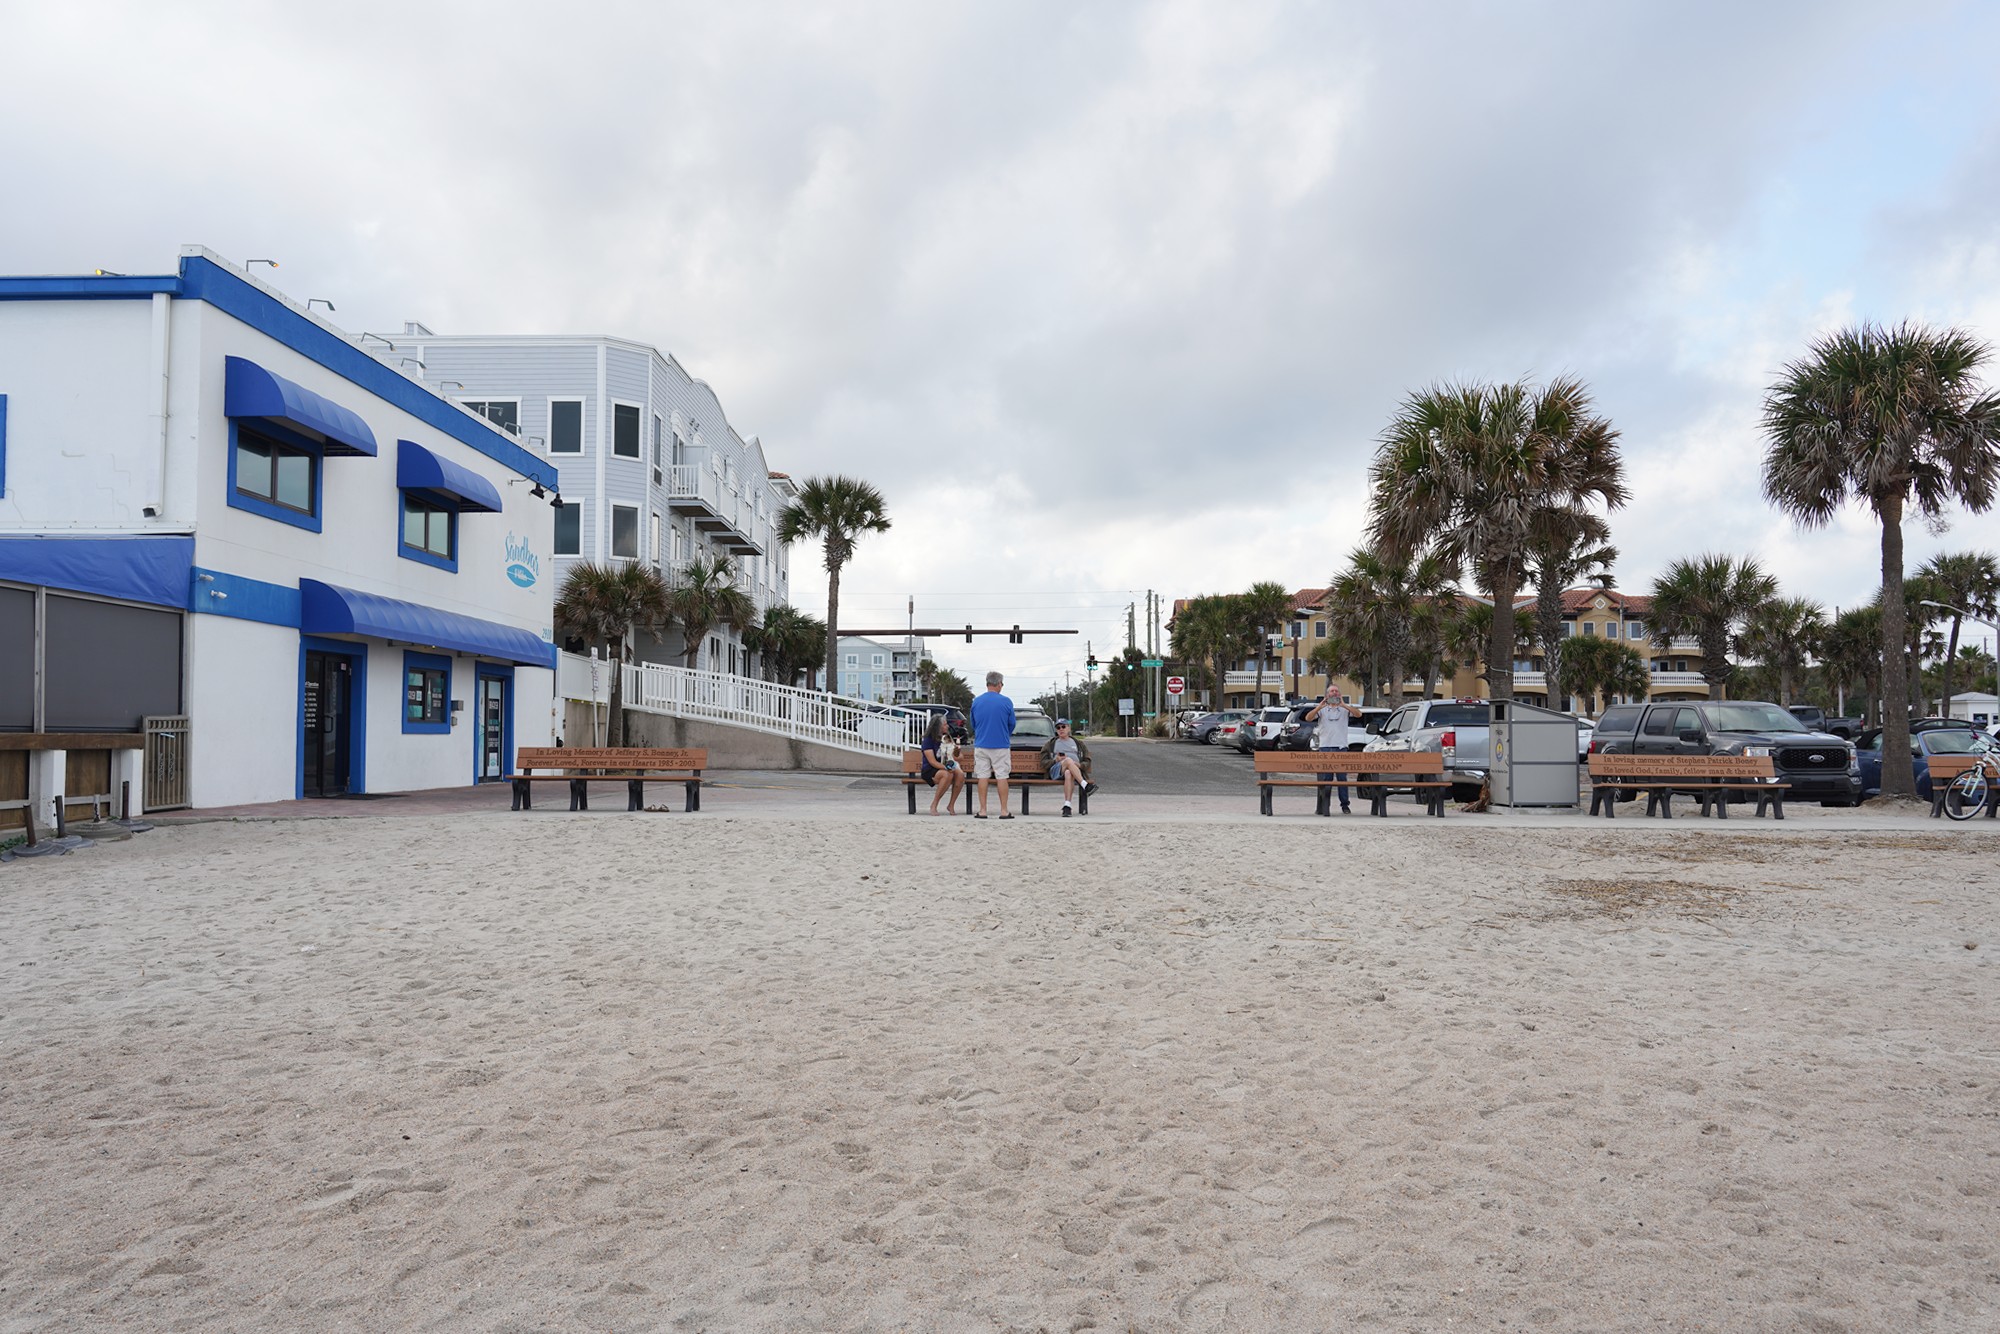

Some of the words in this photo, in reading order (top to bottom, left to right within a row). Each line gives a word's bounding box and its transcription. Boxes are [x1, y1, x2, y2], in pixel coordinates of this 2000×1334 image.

[536, 748, 545, 756] In
[546, 748, 572, 757] Loving
[574, 748, 604, 758] Memory
[605, 748, 613, 756] of
[615, 748, 641, 758] Jeffery
[642, 749, 650, 757] S.
[680, 750, 689, 758] Jr.
[1290, 752, 1328, 760] Dominick
[526, 759, 553, 767] Forever
[554, 759, 579, 768] Loved,
[580, 759, 607, 767] Forever
[609, 759, 617, 767] in
[632, 759, 656, 767] Hearts
[658, 759, 674, 767] 1985
[1614, 756, 1636, 765] loving
[1637, 757, 1666, 766] memory
[1667, 757, 1675, 765] of
[1676, 757, 1706, 766] Stephen
[1707, 757, 1734, 765] Patrick
[1603, 766, 1614, 774] He
[1614, 766, 1635, 774] loved
[1636, 767, 1654, 775] God,
[1655, 767, 1682, 776] family,
[1683, 767, 1707, 775] fellow
